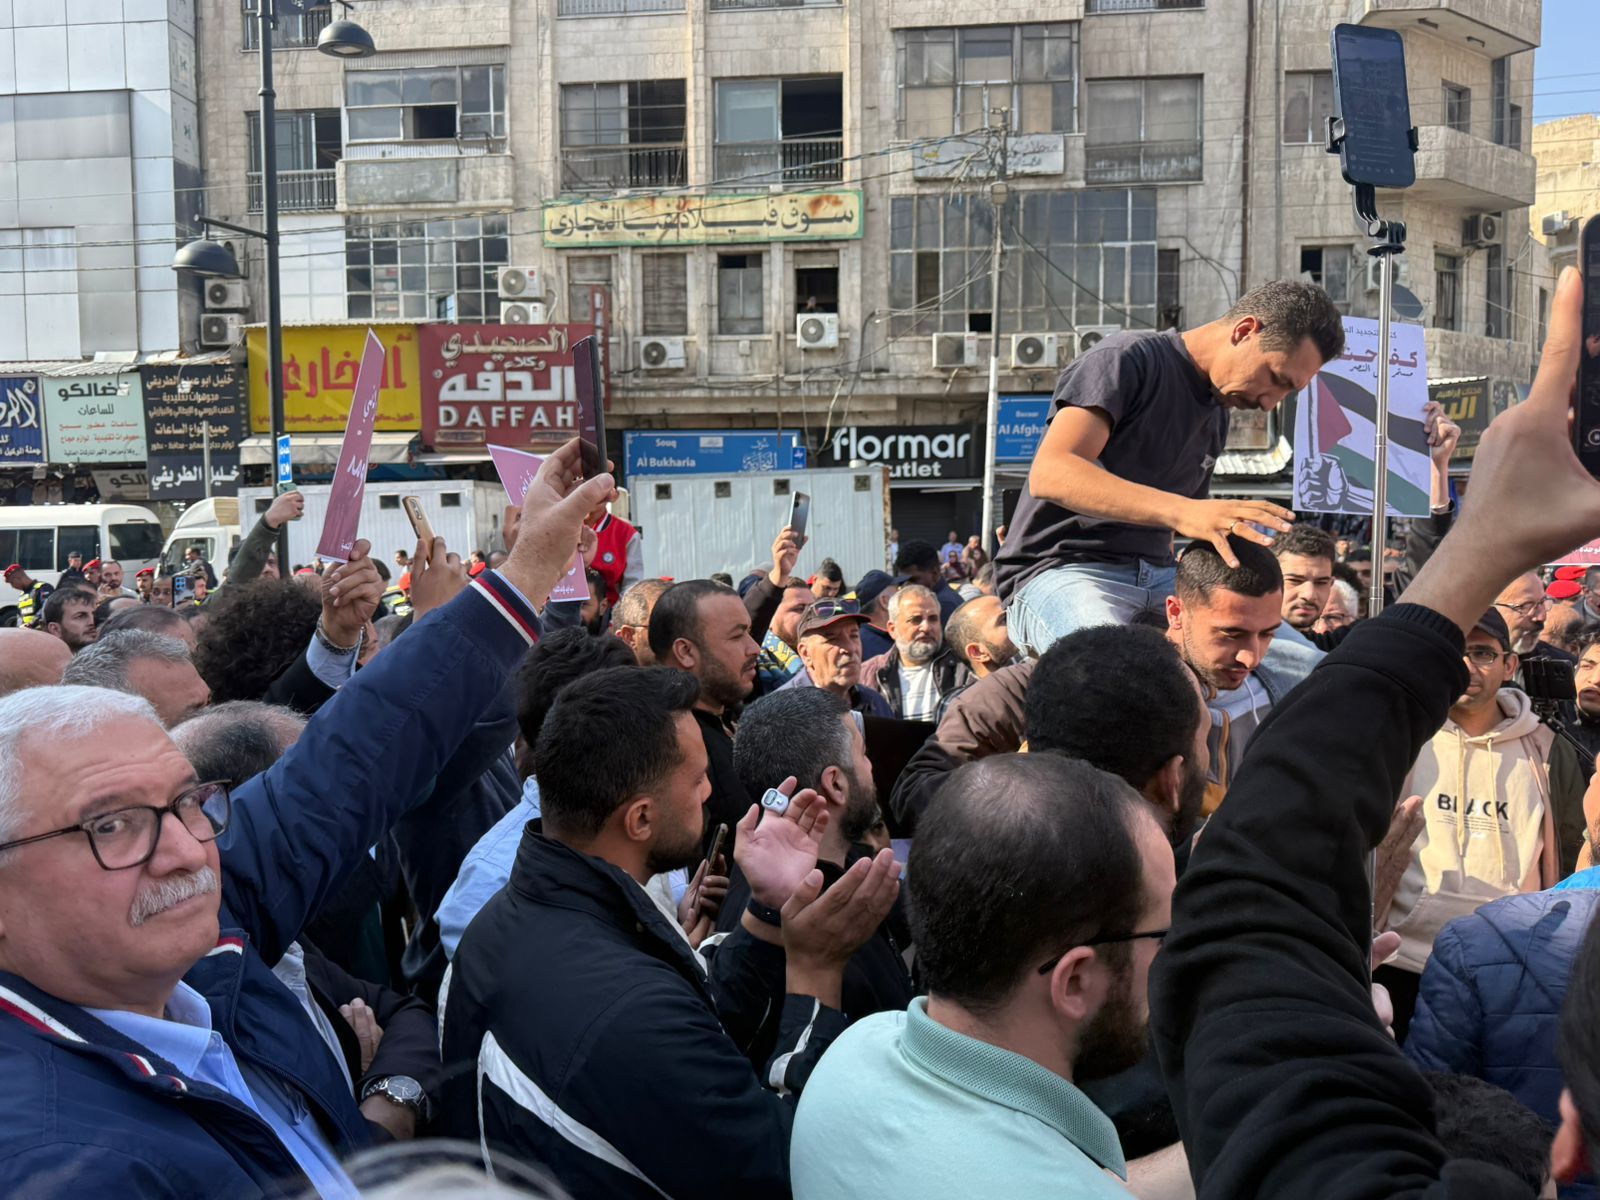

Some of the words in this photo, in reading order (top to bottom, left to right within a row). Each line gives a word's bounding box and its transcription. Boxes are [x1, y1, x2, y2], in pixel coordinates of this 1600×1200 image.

[781, 198, 854, 233] سوق
[504, 355, 547, 371] وكلاء
[58, 381, 131, 402] ضالكو
[78, 403, 115, 416] للساعات
[438, 405, 575, 428] DAFFAH
[154, 422, 188, 435] الساعات
[189, 421, 204, 438] نواع
[998, 424, 1011, 435] Al
[655, 438, 677, 449] Souq
[832, 427, 971, 461] flormar
[636, 456, 648, 468] Al
[650, 455, 697, 468] Bukharia
[151, 464, 203, 491] الطريفي
